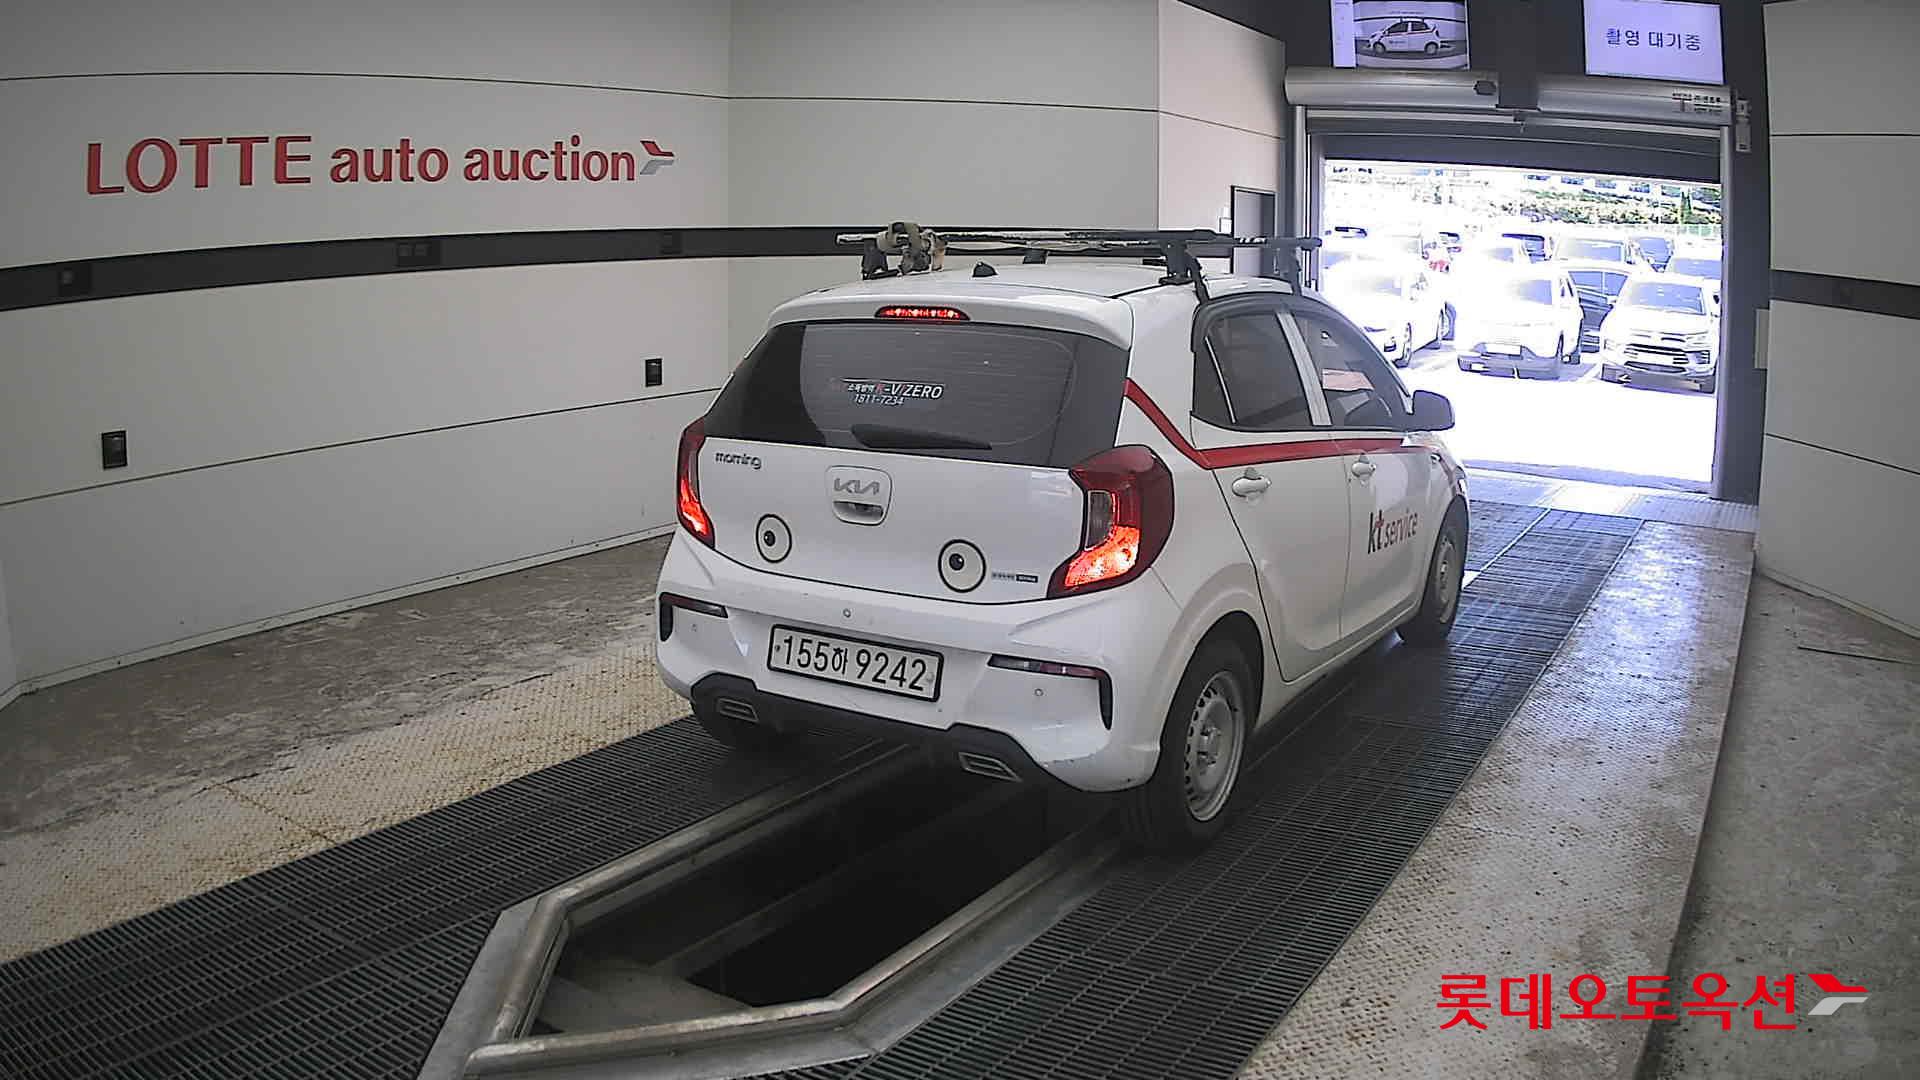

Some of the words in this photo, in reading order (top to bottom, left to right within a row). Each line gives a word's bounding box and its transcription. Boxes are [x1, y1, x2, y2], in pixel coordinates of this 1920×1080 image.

[1606, 28, 1640, 47] 촬영
[1648, 31, 1701, 51] 대기중
[86, 135, 312, 196] LOTTE
[329, 138, 449, 184] auto
[463, 135, 636, 182] auction
[715, 451, 763, 470] morning
[833, 477, 881, 496] KIA
[1367, 509, 1385, 555] kt
[1384, 507, 1419, 549] service
[783, 635, 849, 676] 155하
[855, 648, 927, 692] 9242
